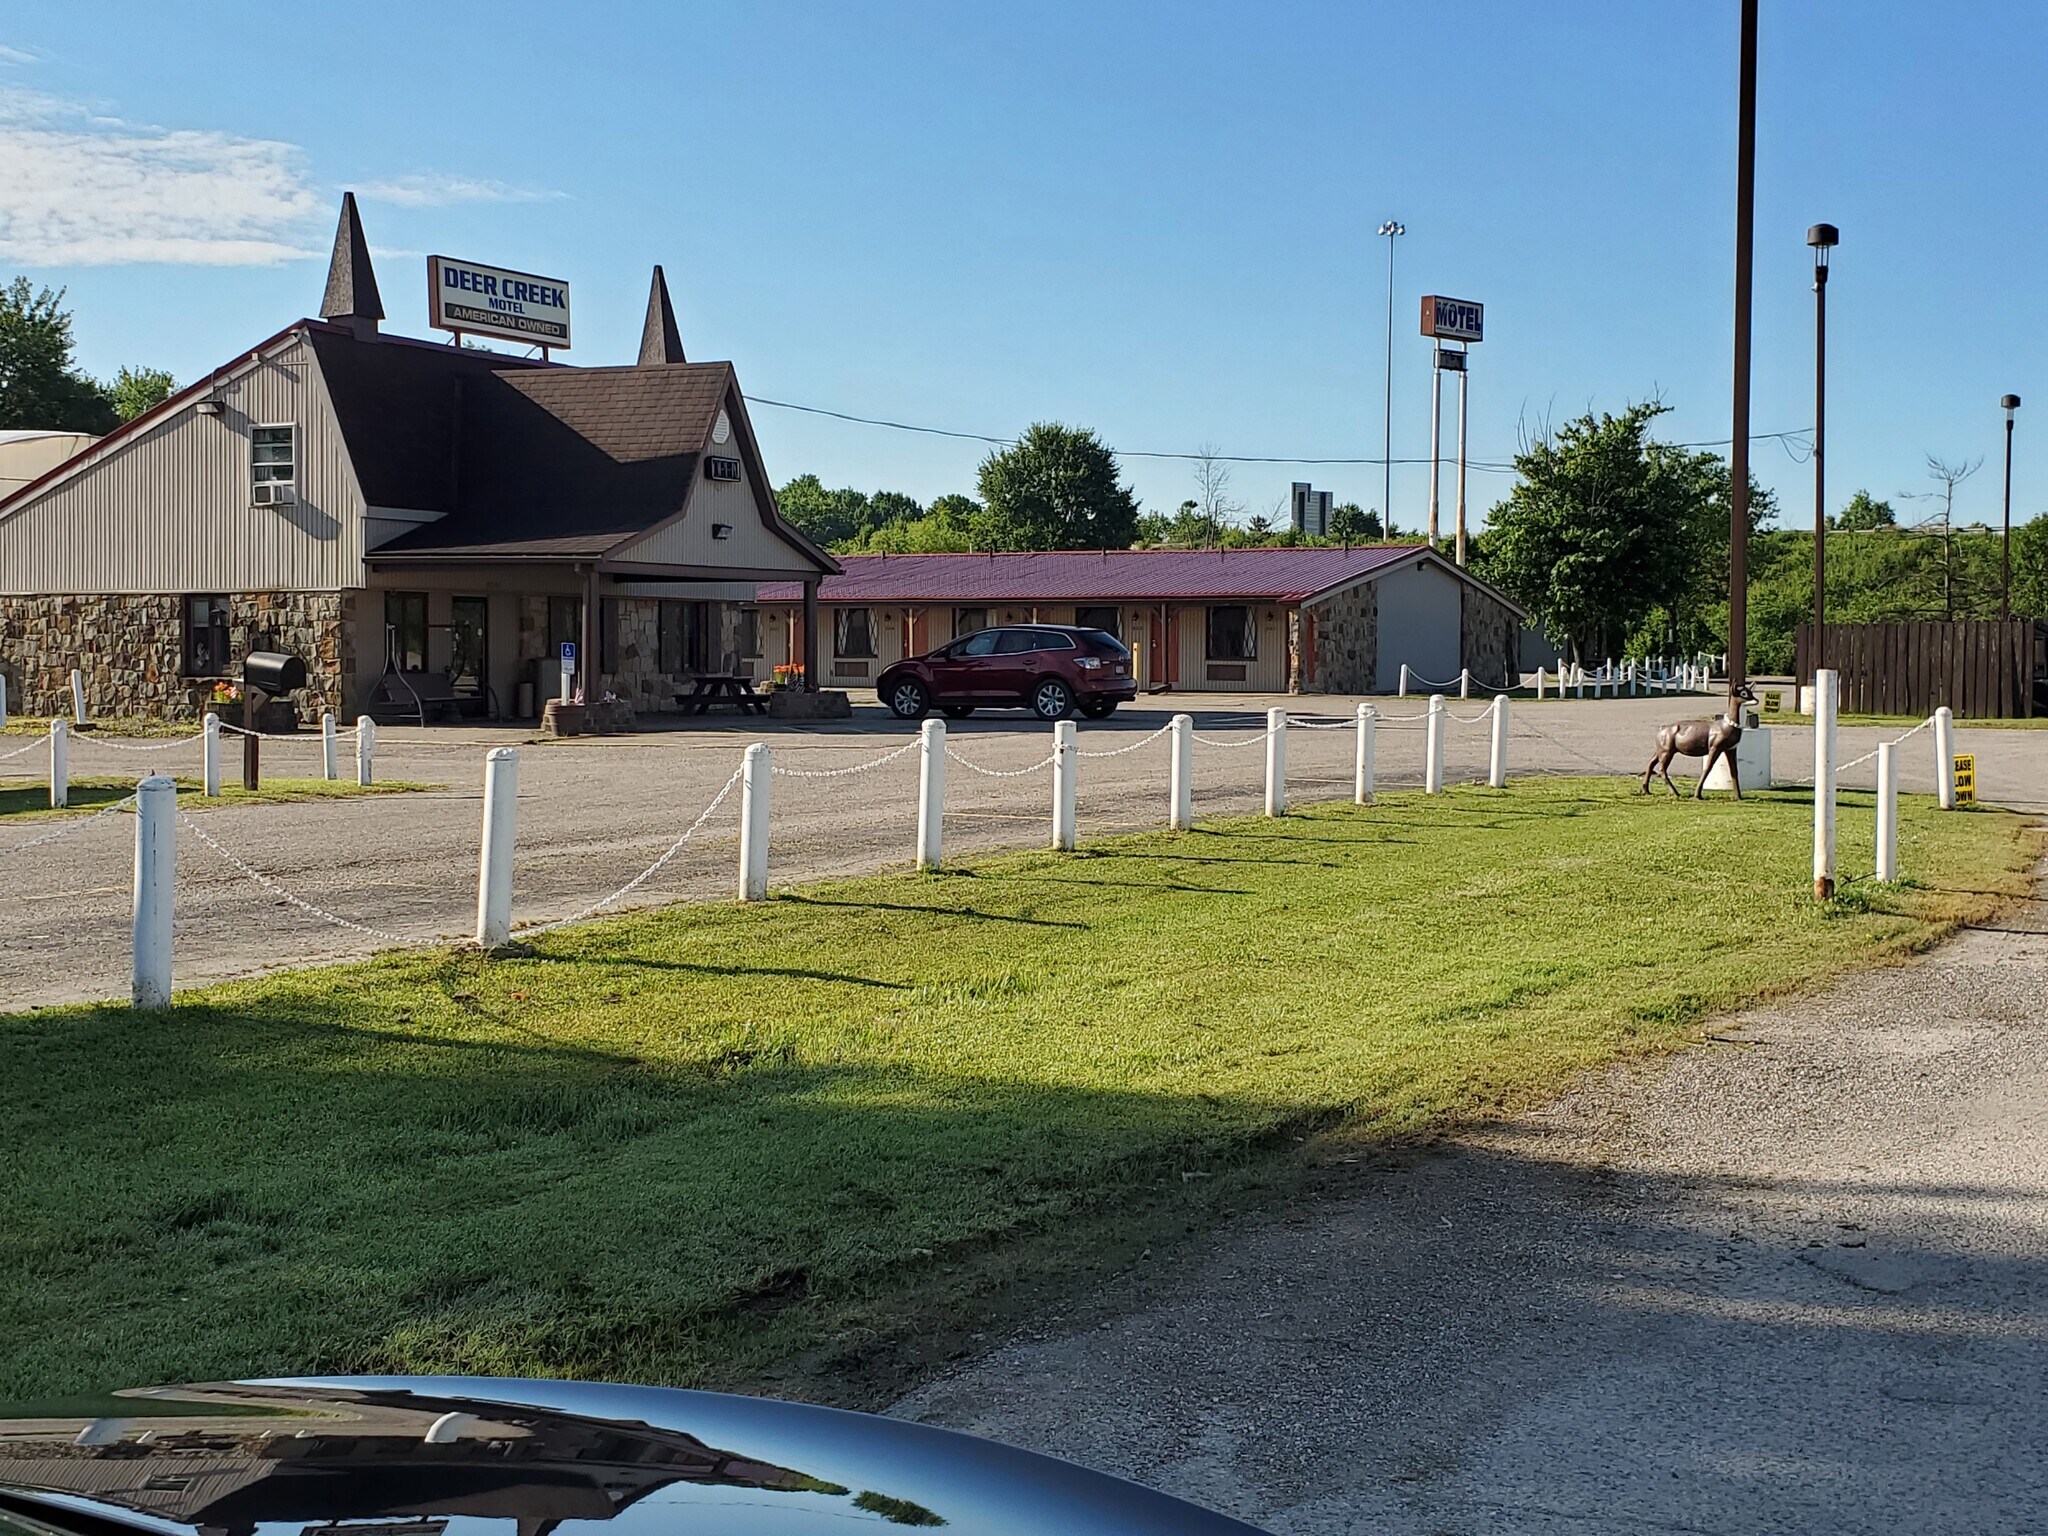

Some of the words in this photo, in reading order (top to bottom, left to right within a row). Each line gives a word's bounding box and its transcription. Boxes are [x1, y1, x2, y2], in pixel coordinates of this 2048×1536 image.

[444, 266, 498, 296] DEER
[502, 278, 566, 309] CREEK
[488, 297, 525, 315] MOTEL
[453, 306, 516, 328] AMERICAN
[518, 318, 560, 335] OWNED
[1436, 302, 1481, 331] MOTEL
[1955, 759, 1972, 771] EASE
[1955, 774, 1972, 787] LOW
[1955, 790, 1973, 802] OWN
